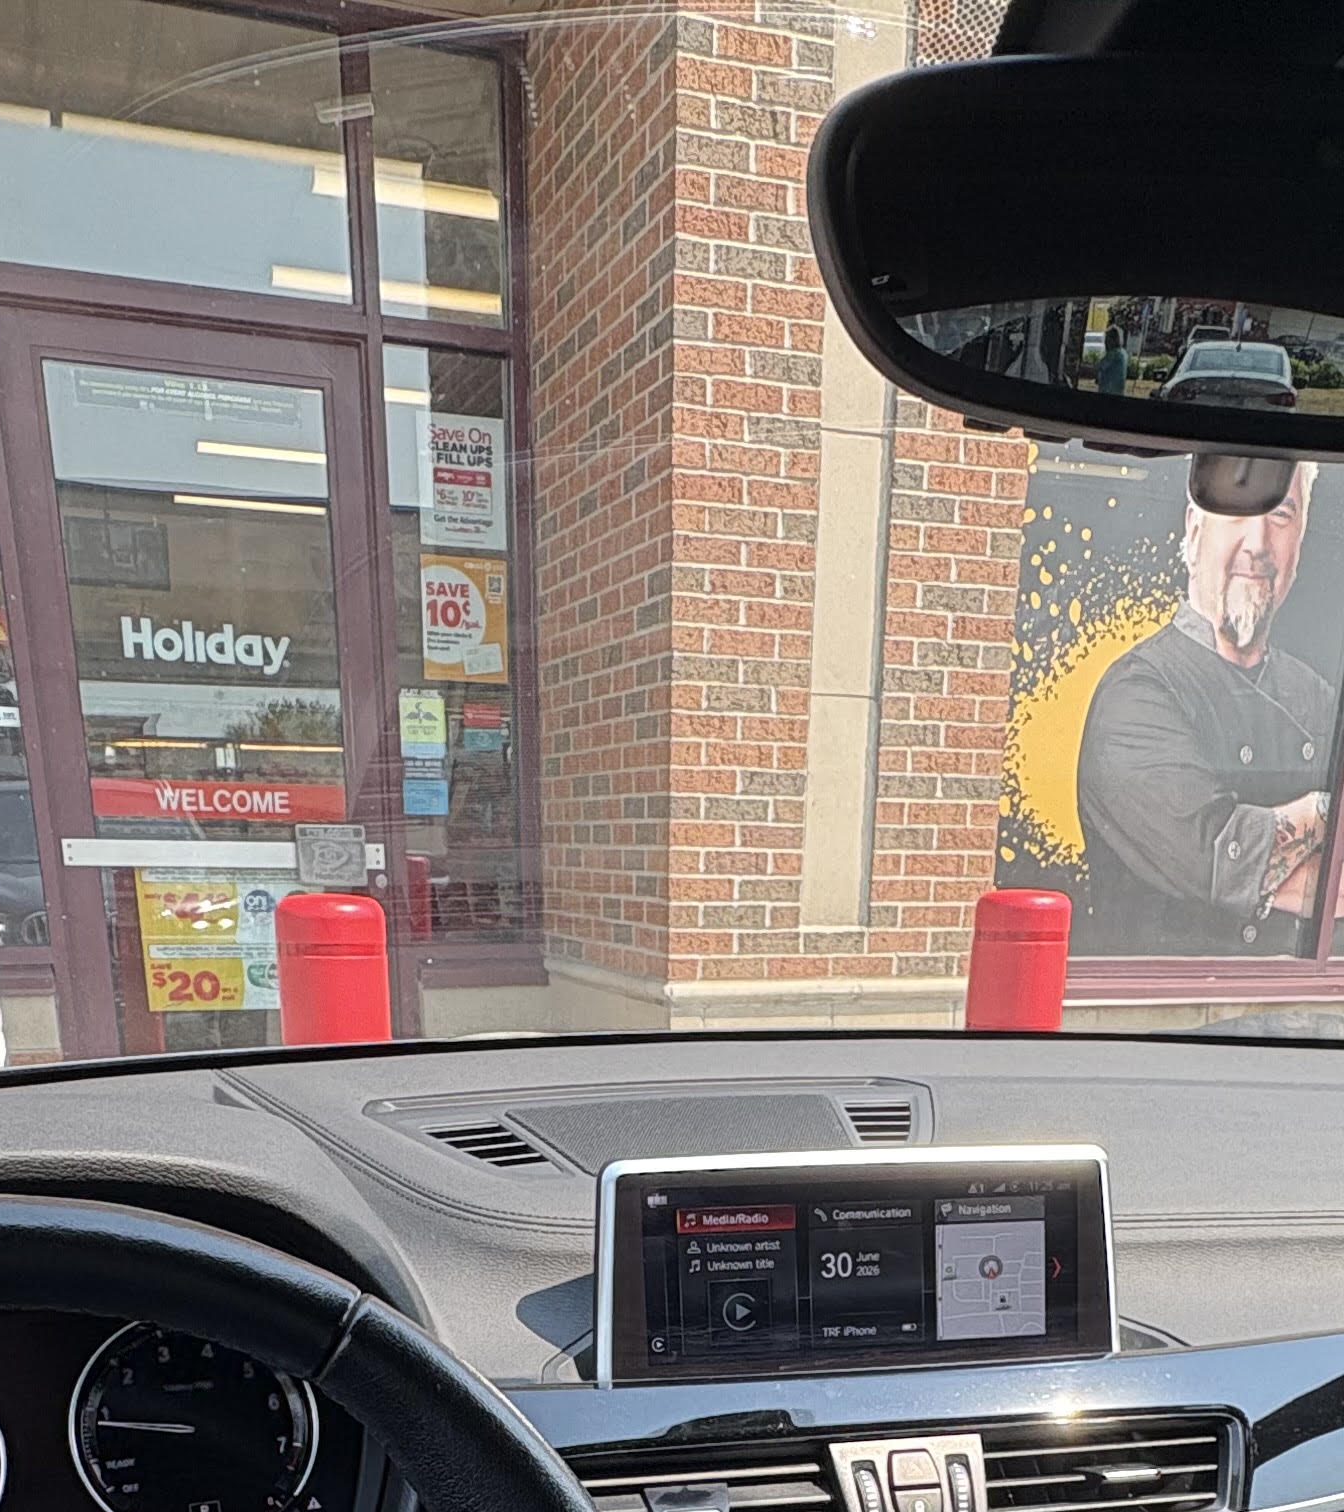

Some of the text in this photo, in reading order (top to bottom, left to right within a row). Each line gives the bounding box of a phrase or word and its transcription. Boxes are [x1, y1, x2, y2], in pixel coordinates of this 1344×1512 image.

[427, 423, 492, 444] Save On
[428, 440, 493, 456] CLEAN UPS
[436, 452, 493, 468] FILL UPS
[426, 581, 469, 598] SAVE
[120, 616, 291, 675] Holiday
[155, 787, 291, 814] WELCOME
[152, 970, 220, 1002] $20
[702, 1204, 1011, 1225] Media/Radio Communication Navigation
[706, 1240, 781, 1254] Unknown artist
[707, 1258, 775, 1272] Unknown title
[820, 1252, 880, 1279] 30 June
[856, 1265, 880, 1276] 2026
[822, 1325, 877, 1338] TRF iPhone
[158, 1346, 170, 1363] 3
[201, 1343, 214, 1358] 4
[122, 1368, 134, 1385] 2
[268, 1393, 280, 1411] 6
[277, 1436, 287, 1453] 7
